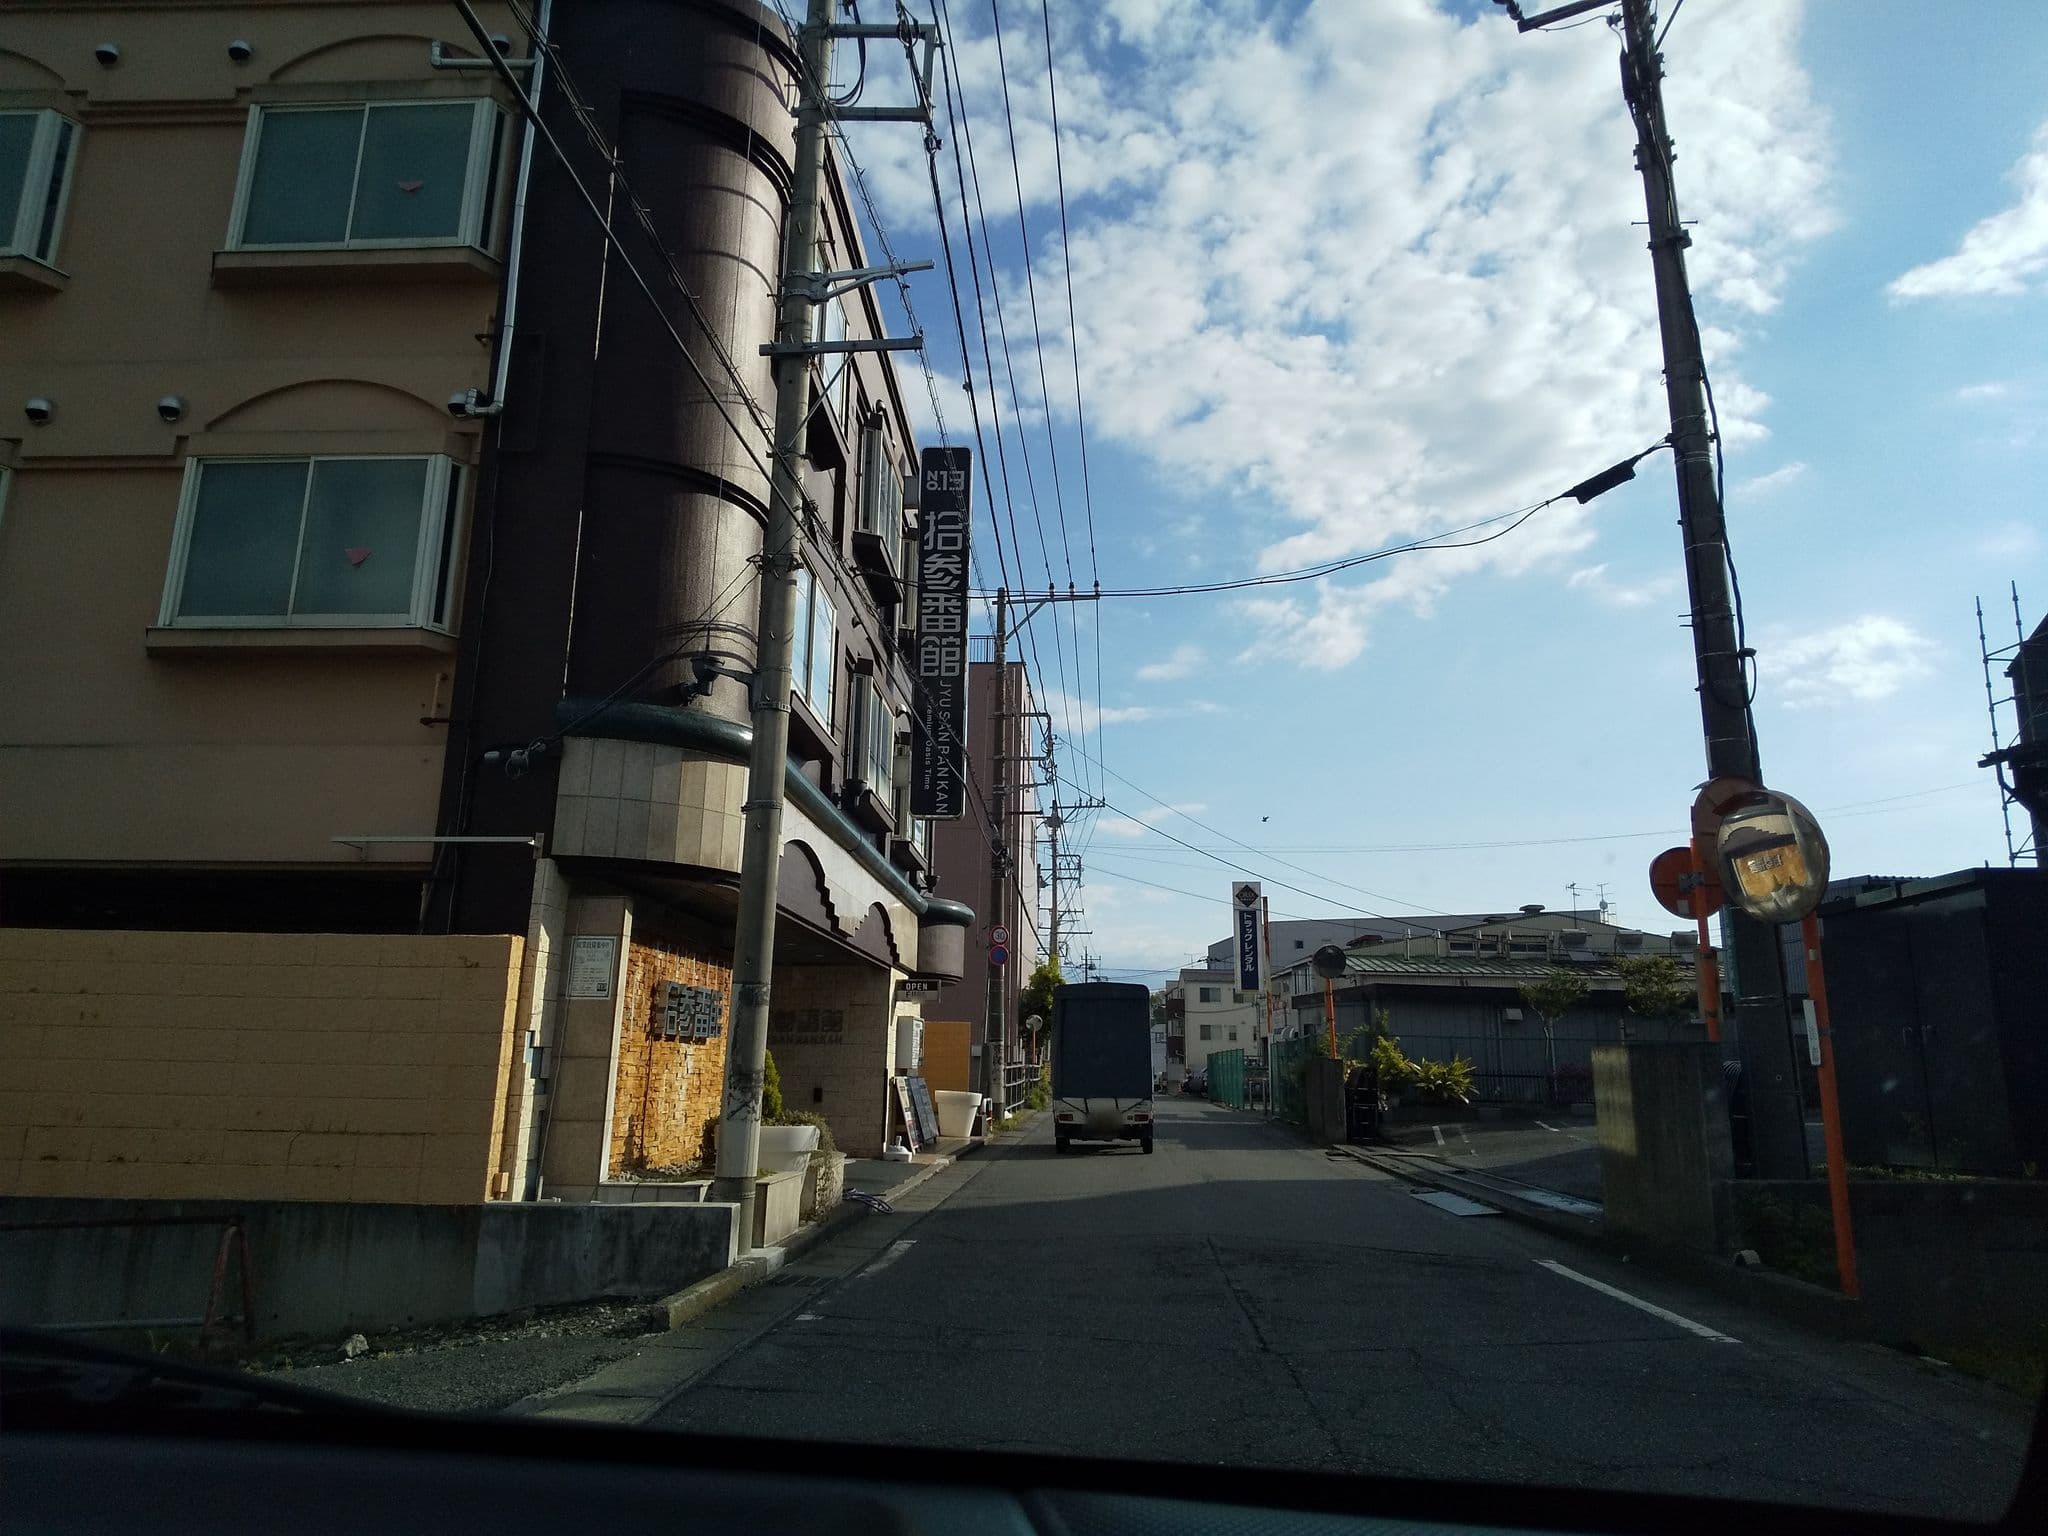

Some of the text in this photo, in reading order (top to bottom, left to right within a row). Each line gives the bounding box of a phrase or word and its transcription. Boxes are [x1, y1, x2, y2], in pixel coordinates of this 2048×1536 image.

[994, 931, 1005, 942] 30
[1243, 912, 1255, 972] トラックレンタル
[905, 982, 928, 991] OPEN
